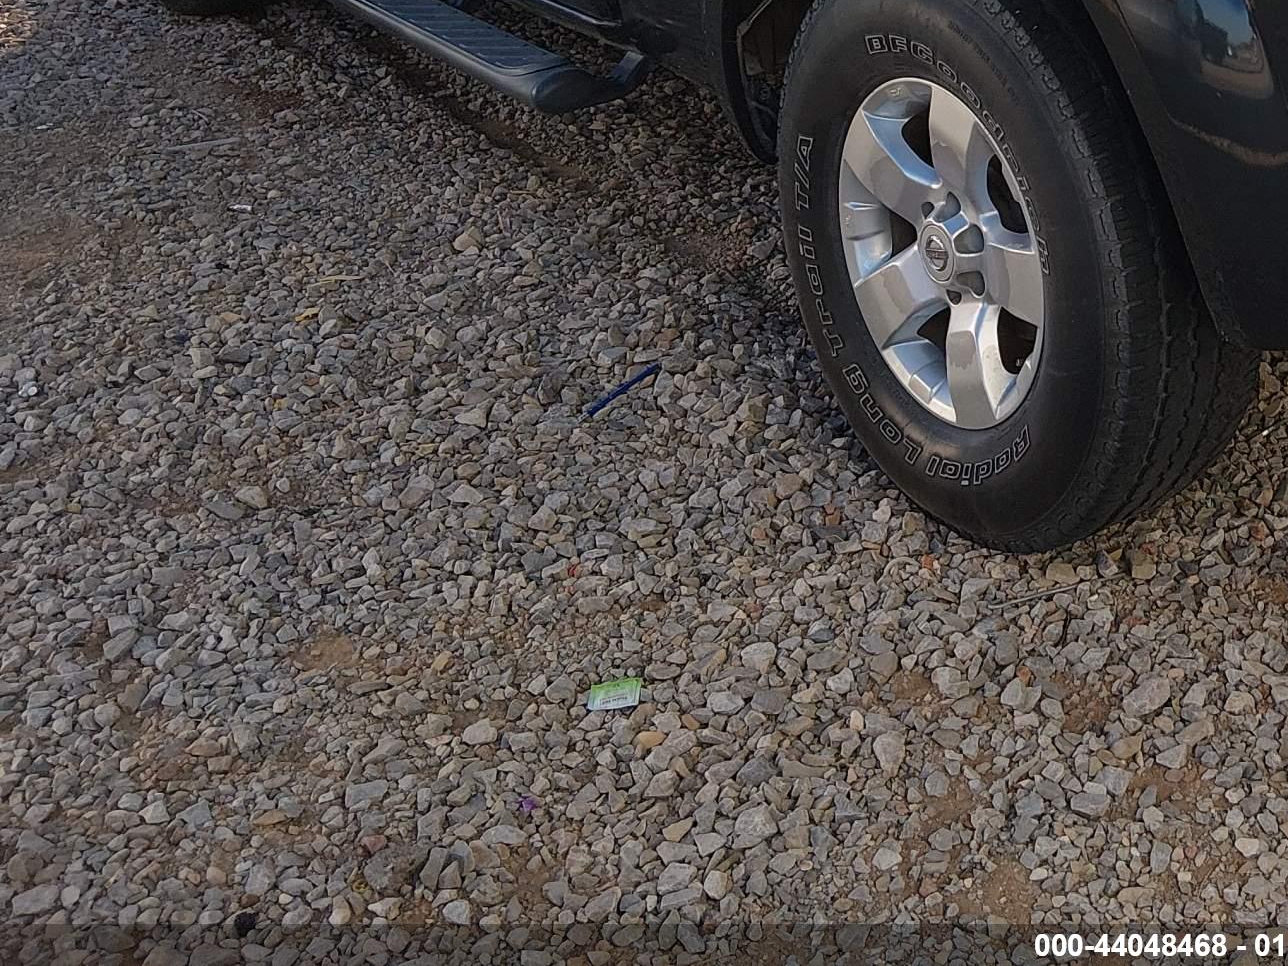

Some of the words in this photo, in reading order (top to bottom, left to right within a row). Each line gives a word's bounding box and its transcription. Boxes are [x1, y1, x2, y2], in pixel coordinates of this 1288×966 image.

[794, 135, 814, 211] T/A
[865, 34, 1050, 275] BFGoodrich
[797, 225, 844, 357] Trail
[842, 363, 924, 465] Long
[925, 424, 1031, 486] Radial
